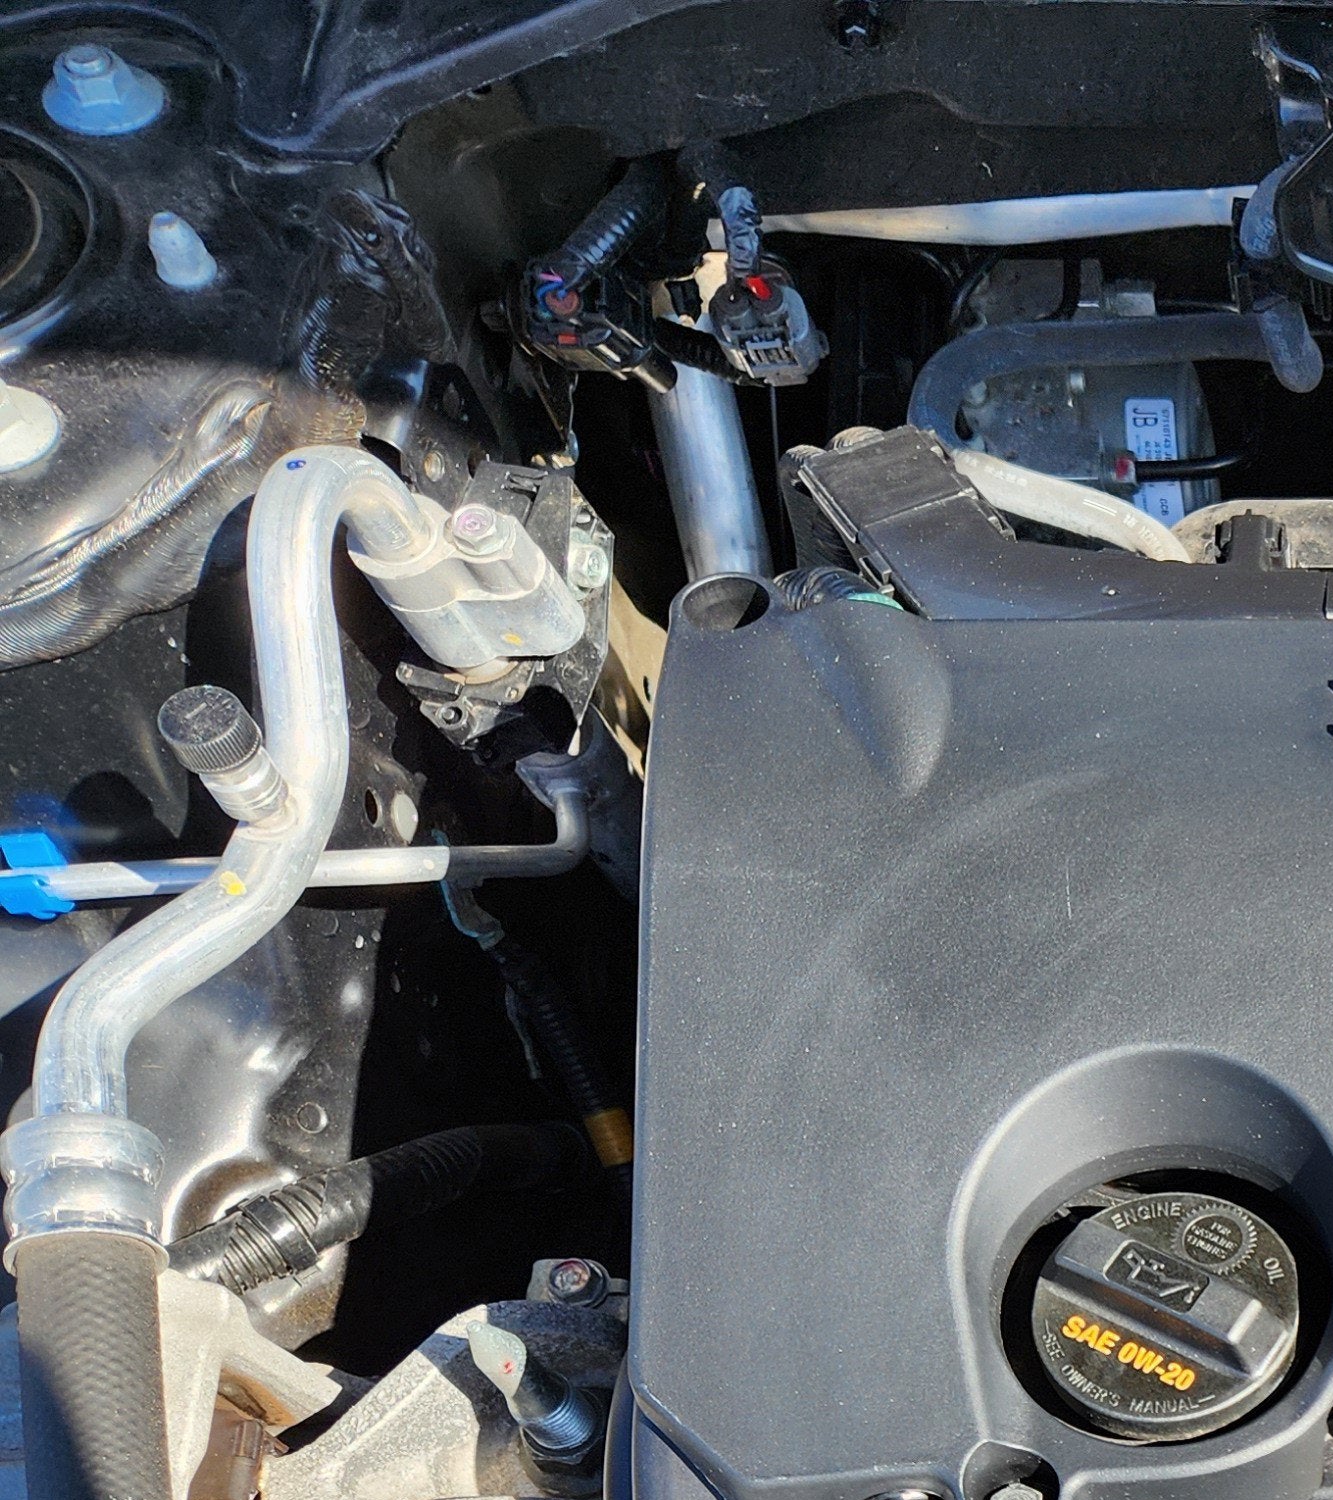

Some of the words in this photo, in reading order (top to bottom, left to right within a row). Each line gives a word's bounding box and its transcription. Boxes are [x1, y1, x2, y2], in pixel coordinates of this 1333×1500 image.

[1132, 407, 1159, 428] JB
[1110, 1201, 1183, 1231] ENGINE
[1262, 1256, 1286, 1285] OIL
[1061, 1314, 1122, 1356] SAE
[1116, 1340, 1197, 1392] 0W-20
[1060, 1363, 1122, 1409] OWNER'S
